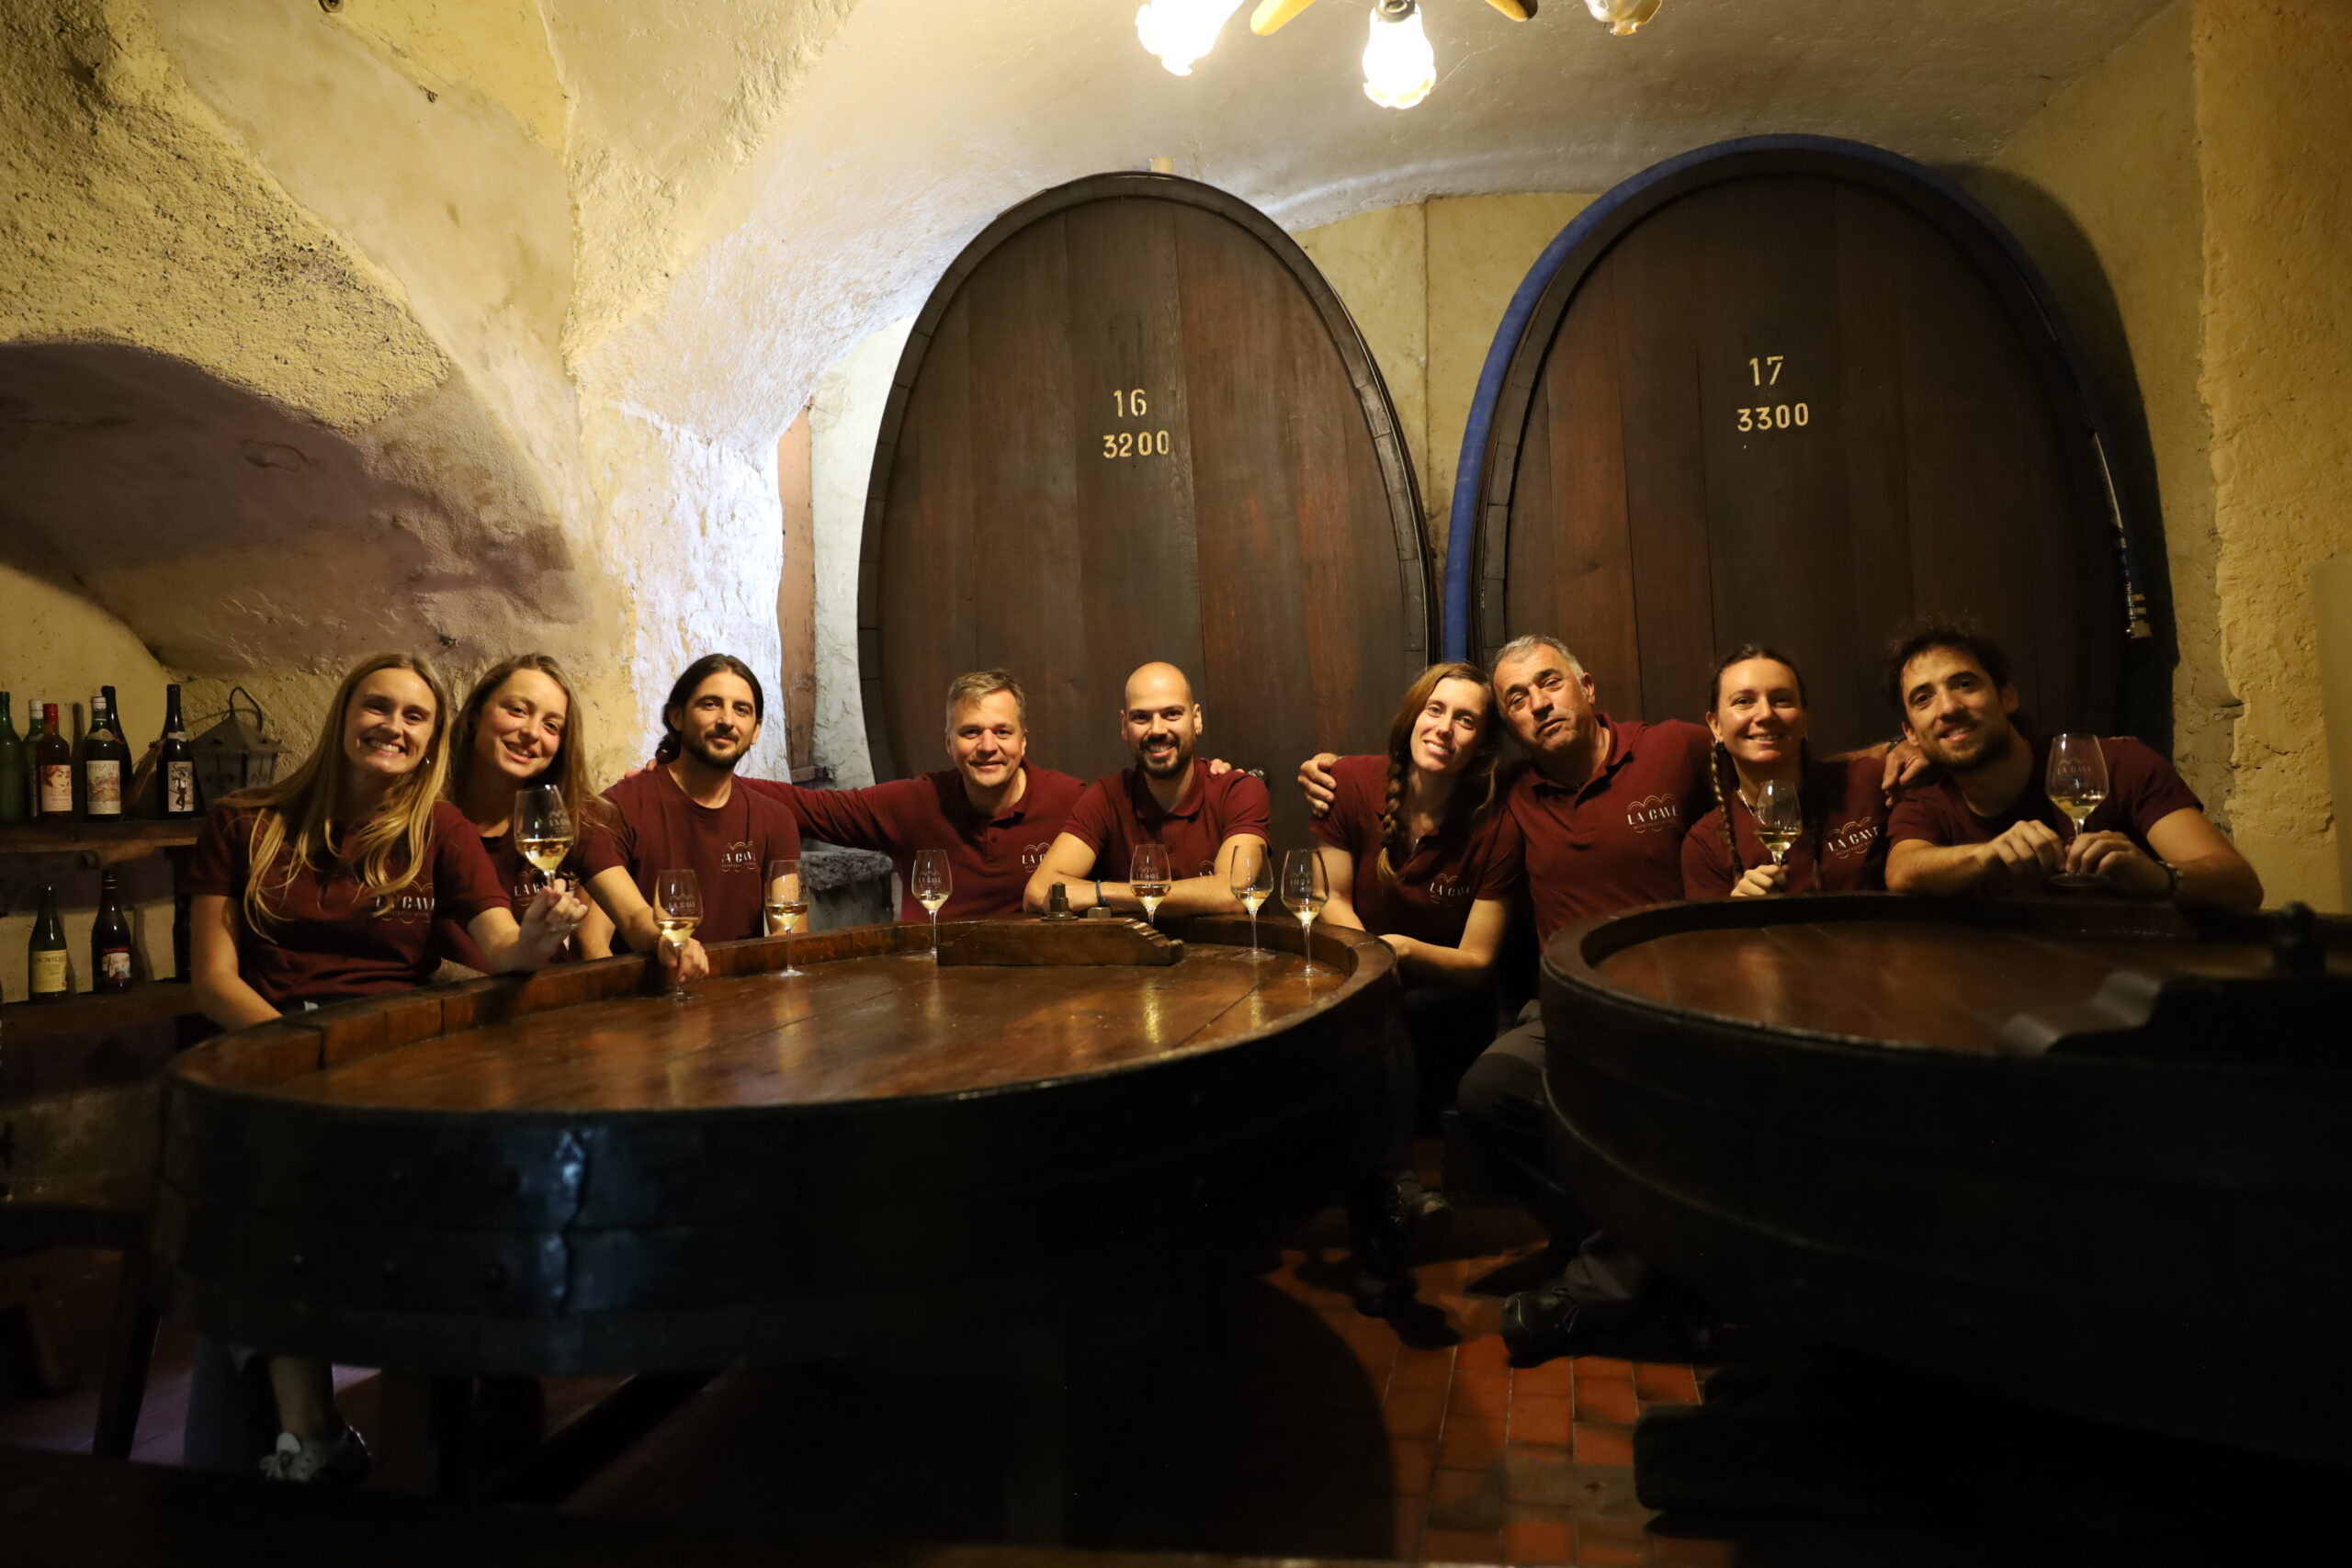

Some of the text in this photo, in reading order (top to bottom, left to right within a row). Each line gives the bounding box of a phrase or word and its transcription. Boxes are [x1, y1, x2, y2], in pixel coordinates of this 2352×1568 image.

[1749, 355, 1784, 386] 17
[1114, 389, 1147, 417] 16
[1737, 403, 1809, 432] 3300
[1102, 430, 1169, 458] 3200
[1627, 812, 1645, 826] LA
[1648, 805, 1679, 820] CAVE
[1827, 838, 1847, 852] LA
[1022, 854, 1035, 864] LA
[514, 884, 530, 897] LA
